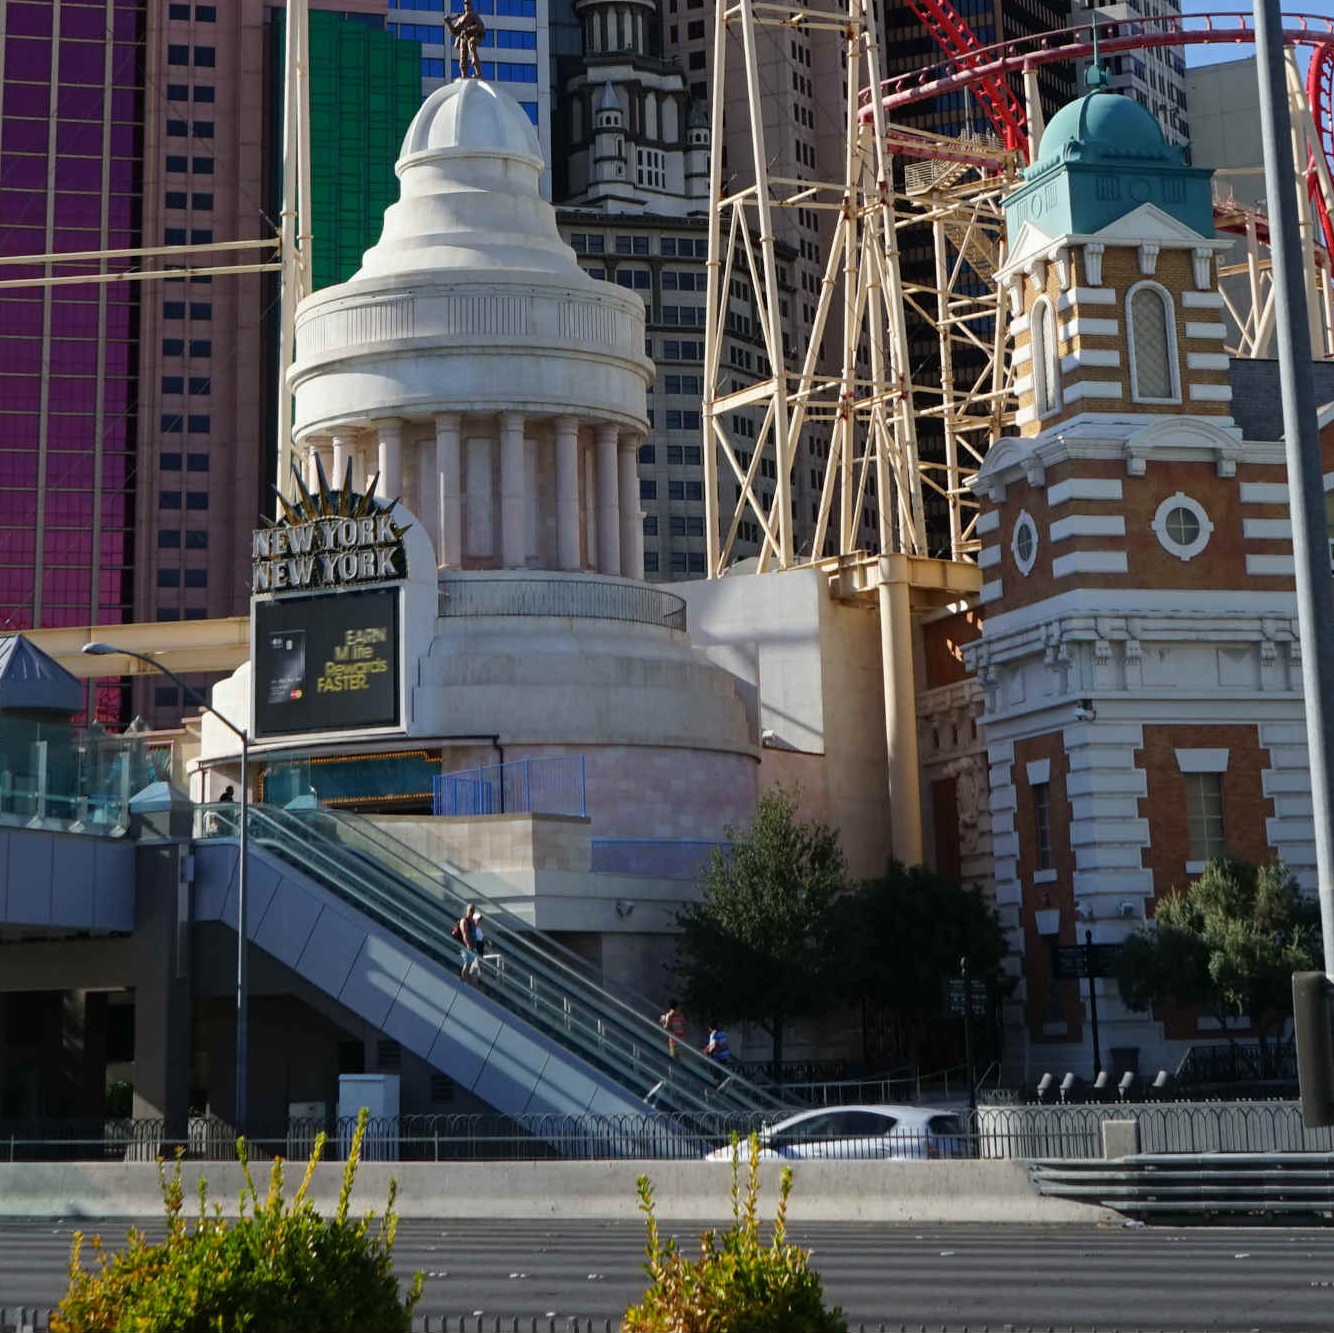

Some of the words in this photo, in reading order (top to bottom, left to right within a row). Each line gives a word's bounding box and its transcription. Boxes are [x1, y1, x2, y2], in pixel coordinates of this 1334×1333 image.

[252, 523, 315, 556] NEW
[318, 515, 397, 551] YORK
[253, 555, 315, 589] NEW
[319, 547, 398, 584] YORK
[345, 626, 387, 647] EARN
[324, 657, 388, 676] Rewards
